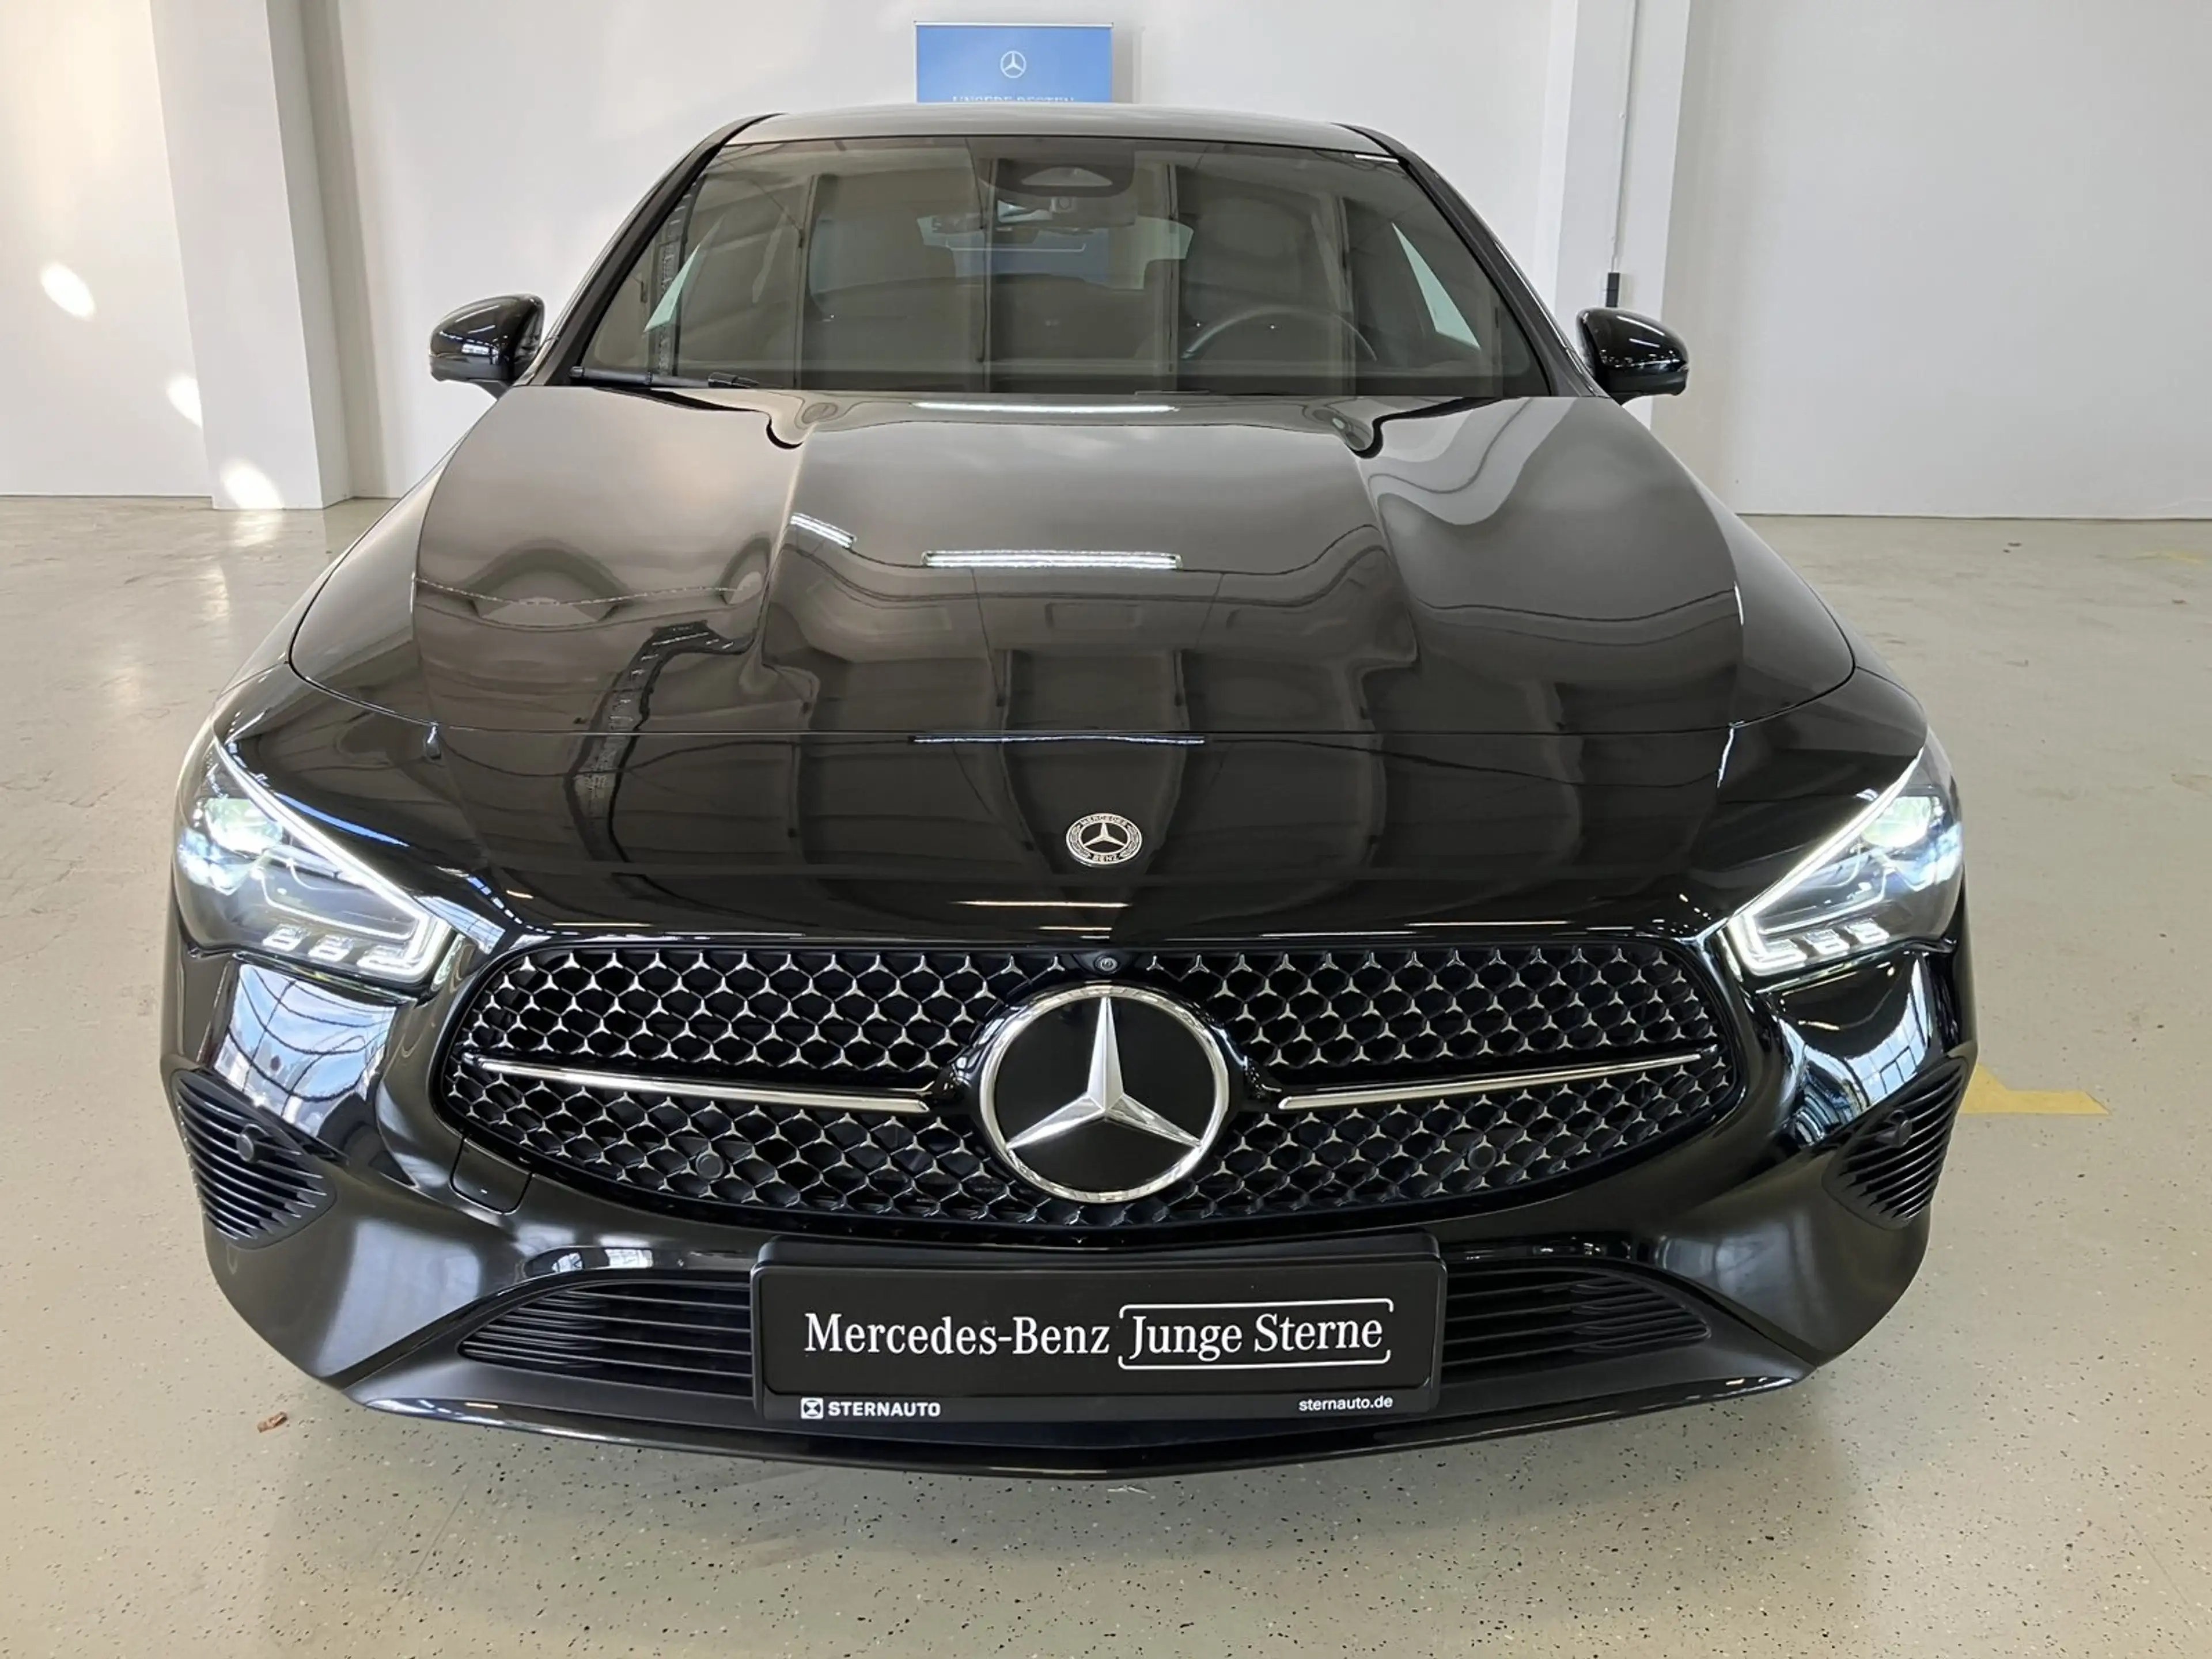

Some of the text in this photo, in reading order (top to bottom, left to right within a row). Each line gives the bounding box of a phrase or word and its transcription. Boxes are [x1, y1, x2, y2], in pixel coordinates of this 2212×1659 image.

[804, 1313, 1383, 1362] Mercedes-Benz Junge Sterne
[828, 1401, 941, 1417] STERNAUTO
[1298, 1395, 1393, 1411] sternauto.de
